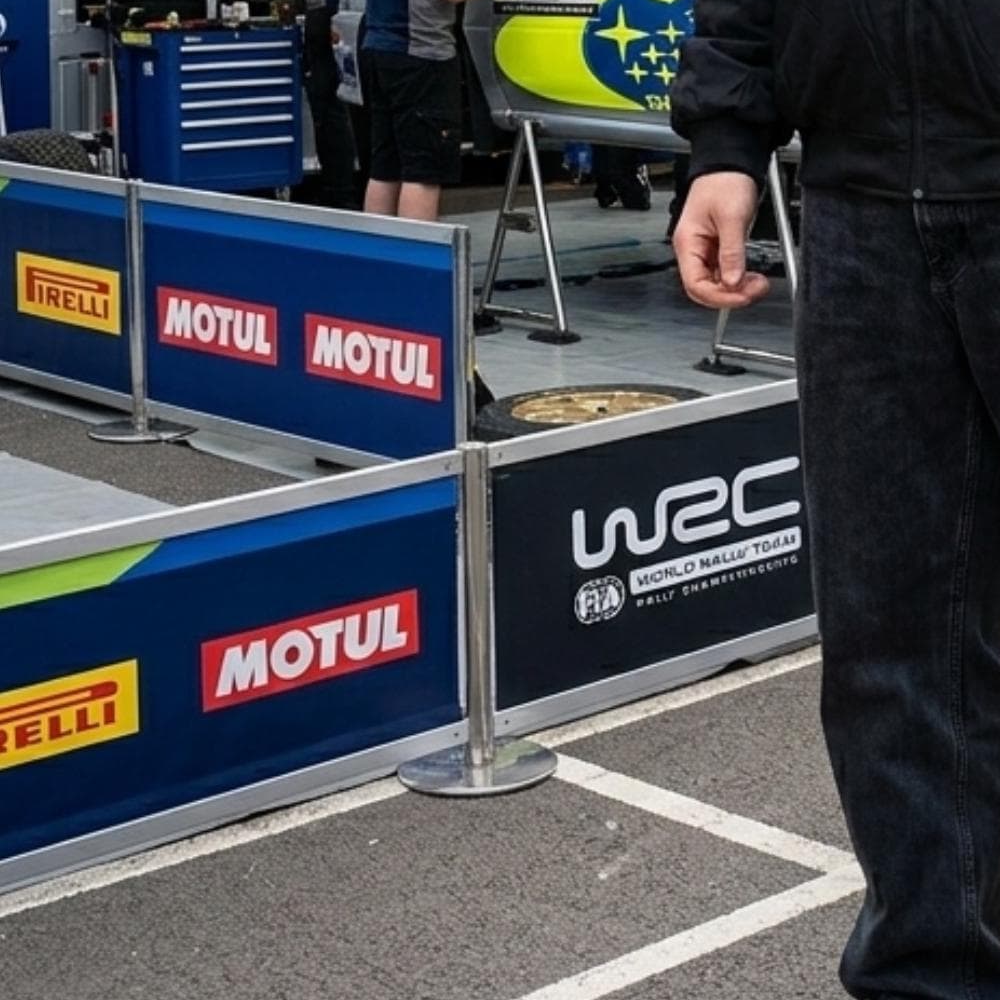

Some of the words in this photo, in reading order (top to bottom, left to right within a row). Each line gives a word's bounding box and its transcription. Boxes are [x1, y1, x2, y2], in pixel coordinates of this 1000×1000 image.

[26, 266, 110, 320] PIRELLI
[164, 297, 271, 355] MOTUL
[312, 325, 434, 388] MOTUL
[572, 456, 800, 570] WRC
[215, 604, 407, 698] MOTUL
[0, 681, 118, 753] RELLI
